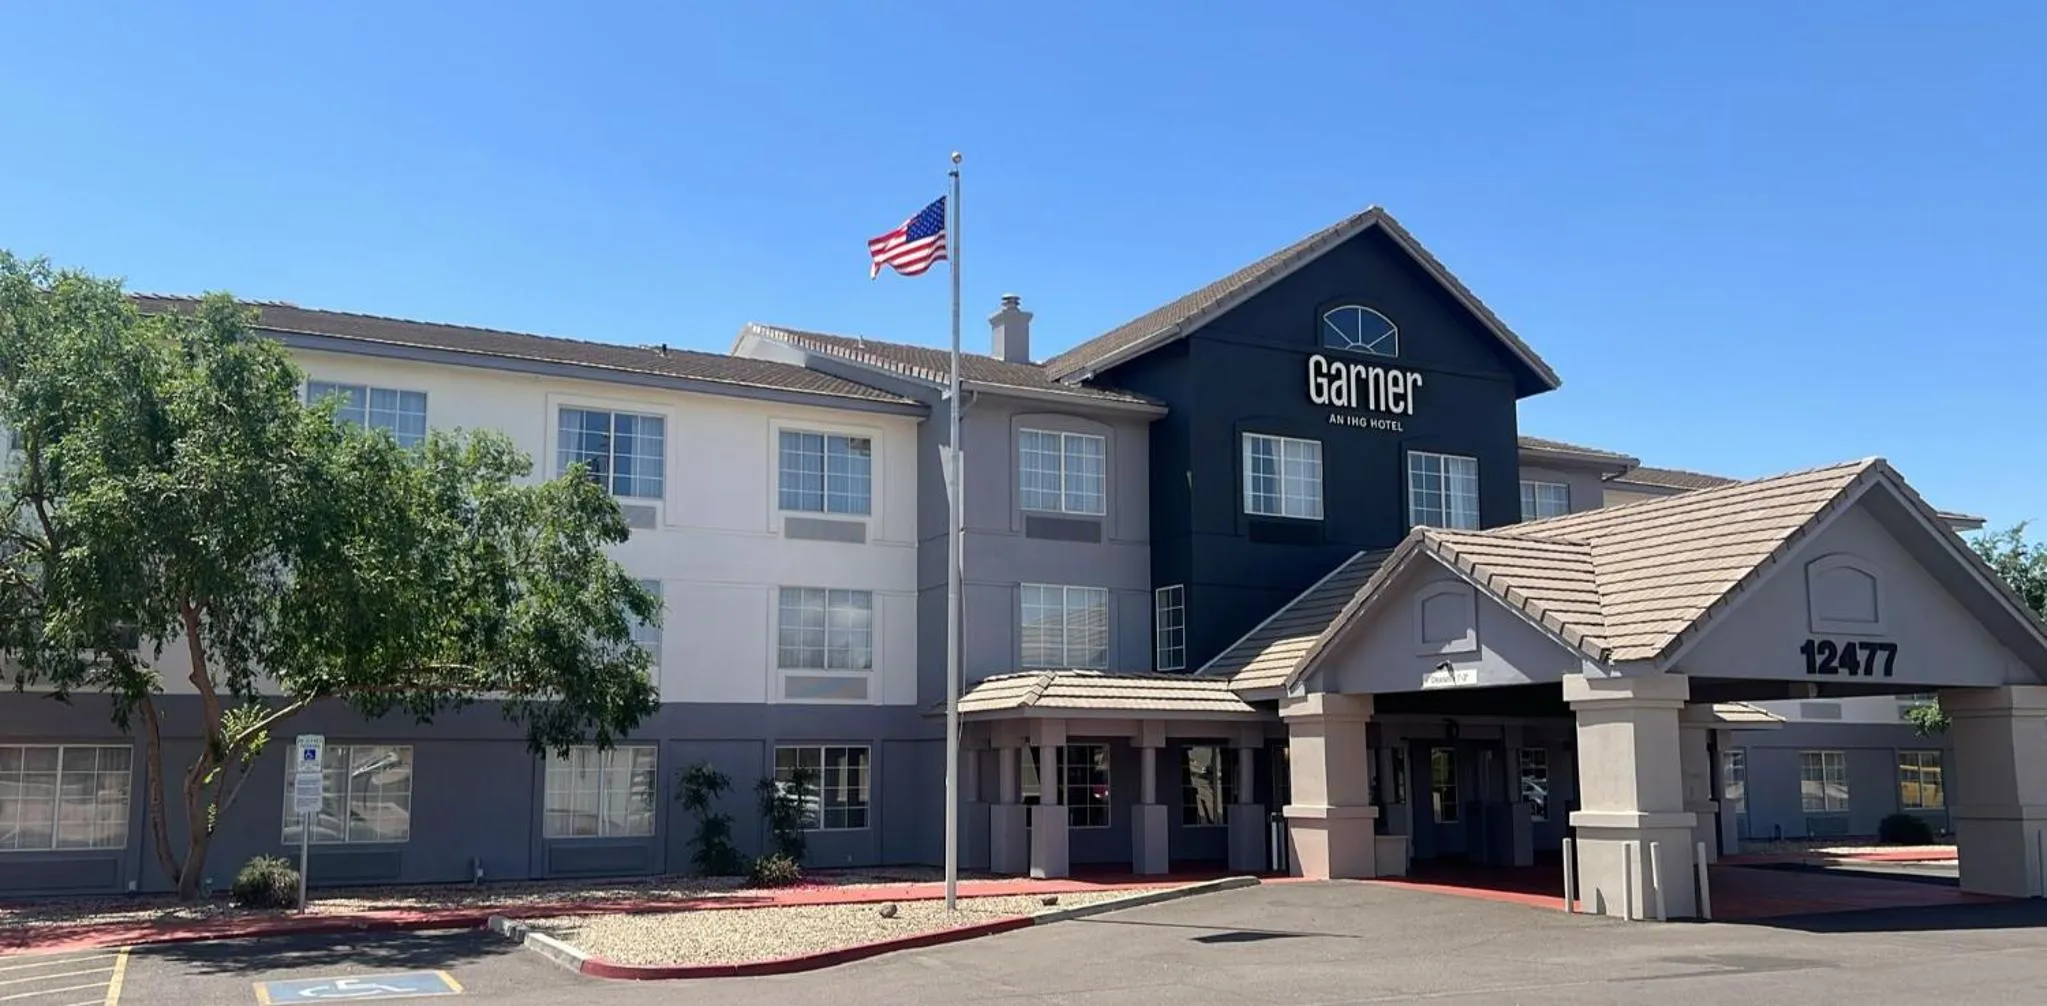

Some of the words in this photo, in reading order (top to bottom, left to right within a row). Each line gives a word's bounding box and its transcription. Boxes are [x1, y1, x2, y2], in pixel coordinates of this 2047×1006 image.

[1308, 354, 1423, 415] Garner
[1329, 413, 1344, 425] AN
[1347, 415, 1367, 428] IHG
[1370, 418, 1404, 432] HOTEL
[1800, 639, 1898, 677] 12477
